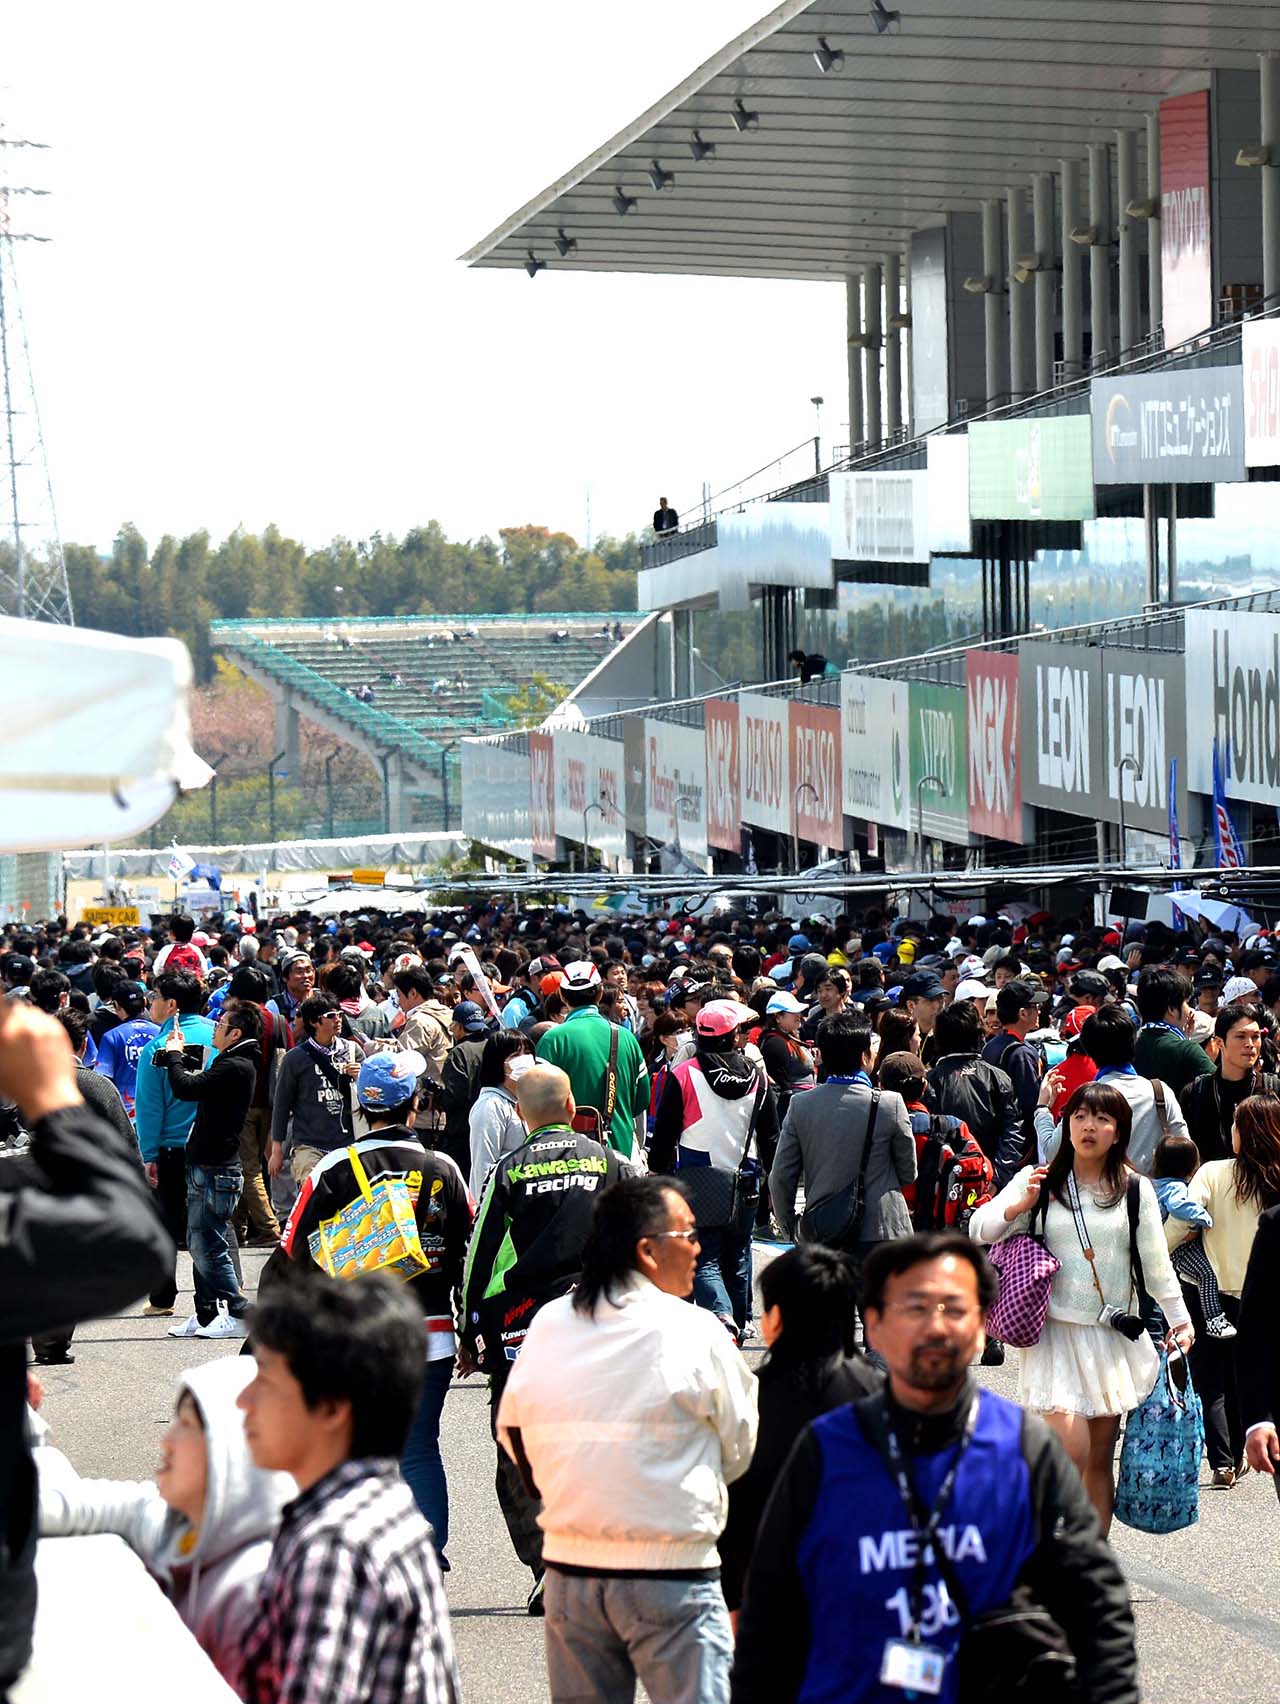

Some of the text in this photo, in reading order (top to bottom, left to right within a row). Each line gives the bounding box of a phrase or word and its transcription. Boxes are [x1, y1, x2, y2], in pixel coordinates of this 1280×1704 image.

[1161, 186, 1208, 268] TOYOTA
[706, 718, 736, 833] NGK
[746, 716, 783, 809] DENSO
[796, 726, 836, 824] DENSO
[920, 708, 955, 797] NIPPO
[968, 675, 1009, 818] NGK
[1036, 664, 1092, 794] LEON
[1107, 672, 1167, 809] LEON
[507, 1156, 608, 1184] Kawasaki
[525, 1174, 600, 1196] racing
